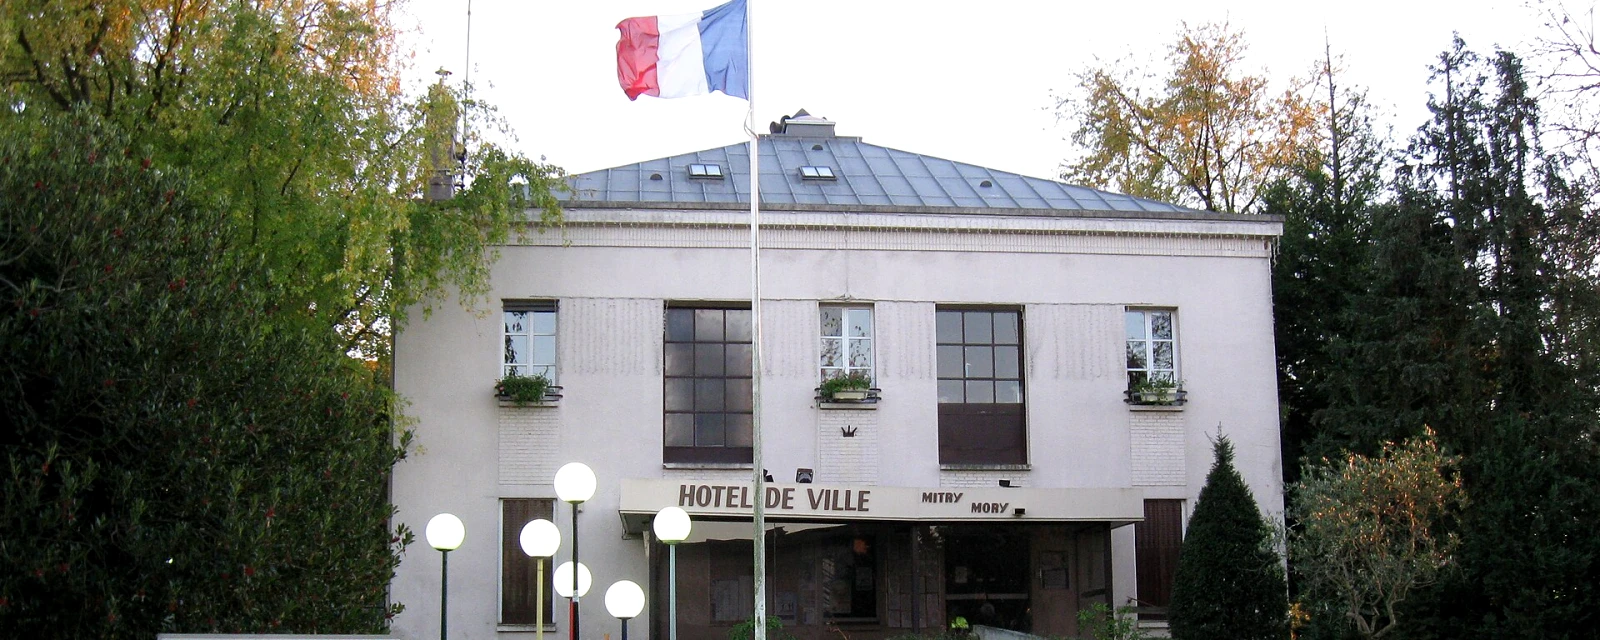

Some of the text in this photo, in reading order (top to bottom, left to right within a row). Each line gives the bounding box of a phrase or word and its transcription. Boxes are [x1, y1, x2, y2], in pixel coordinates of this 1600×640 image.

[678, 484, 871, 512] HOTEL DE VILLE
[921, 491, 964, 504] MITRY
[970, 502, 1010, 514] MORY
